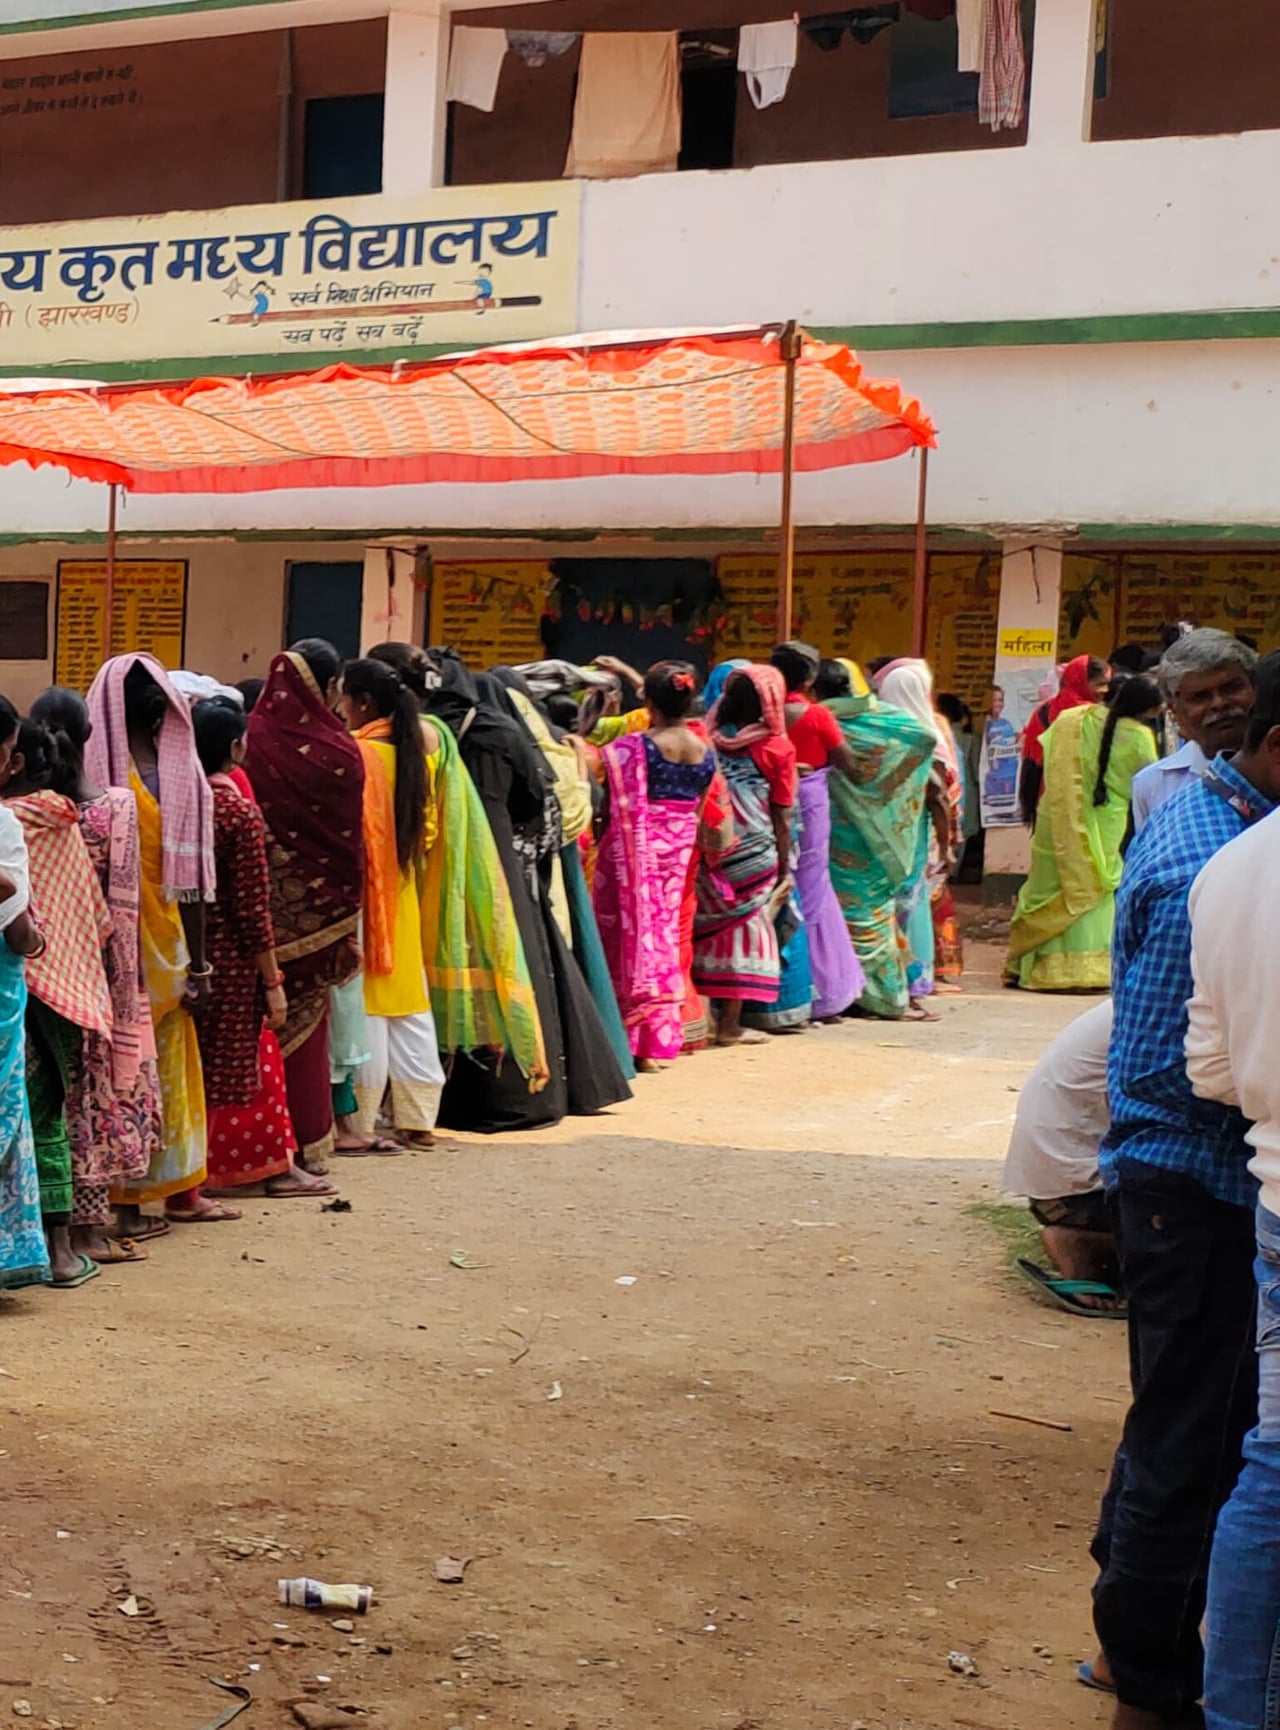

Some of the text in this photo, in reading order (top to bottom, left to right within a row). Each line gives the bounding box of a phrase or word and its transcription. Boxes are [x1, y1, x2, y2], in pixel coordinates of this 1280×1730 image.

[59, 241, 160, 303] कृत
[166, 231, 291, 282] मध्य
[299, 210, 558, 275] विद्यालय
[1003, 636, 1053, 653] महिला
